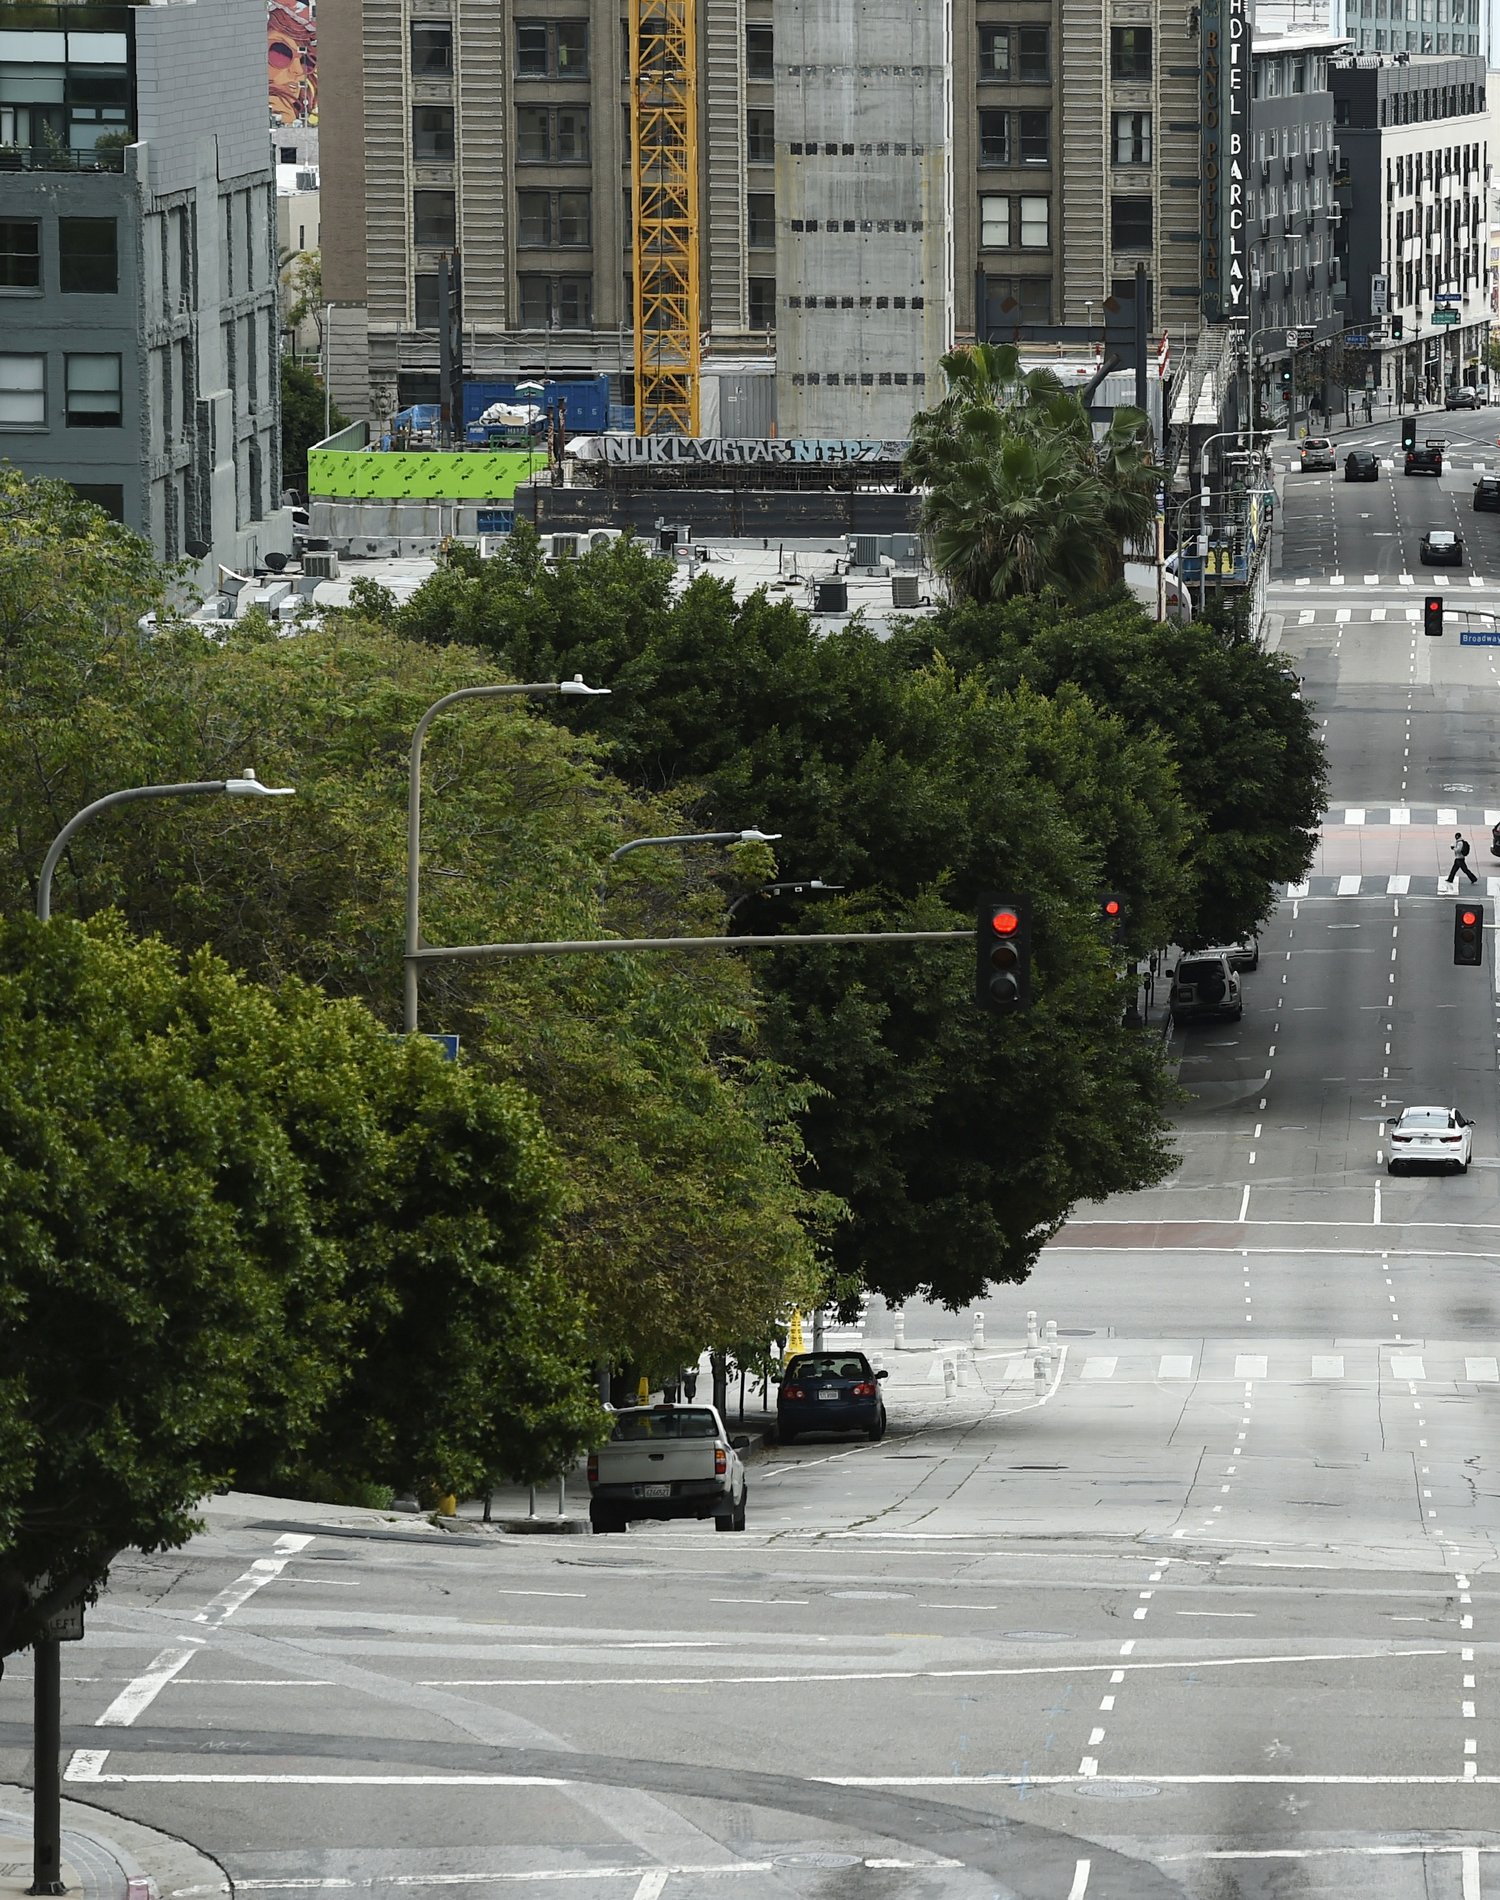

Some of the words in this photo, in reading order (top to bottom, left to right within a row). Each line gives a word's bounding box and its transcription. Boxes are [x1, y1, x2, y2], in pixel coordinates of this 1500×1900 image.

[1205, 31, 1218, 128] BANCO
[1204, 142, 1217, 279] POPULAR
[1230, 133, 1244, 304] BARCLAY
